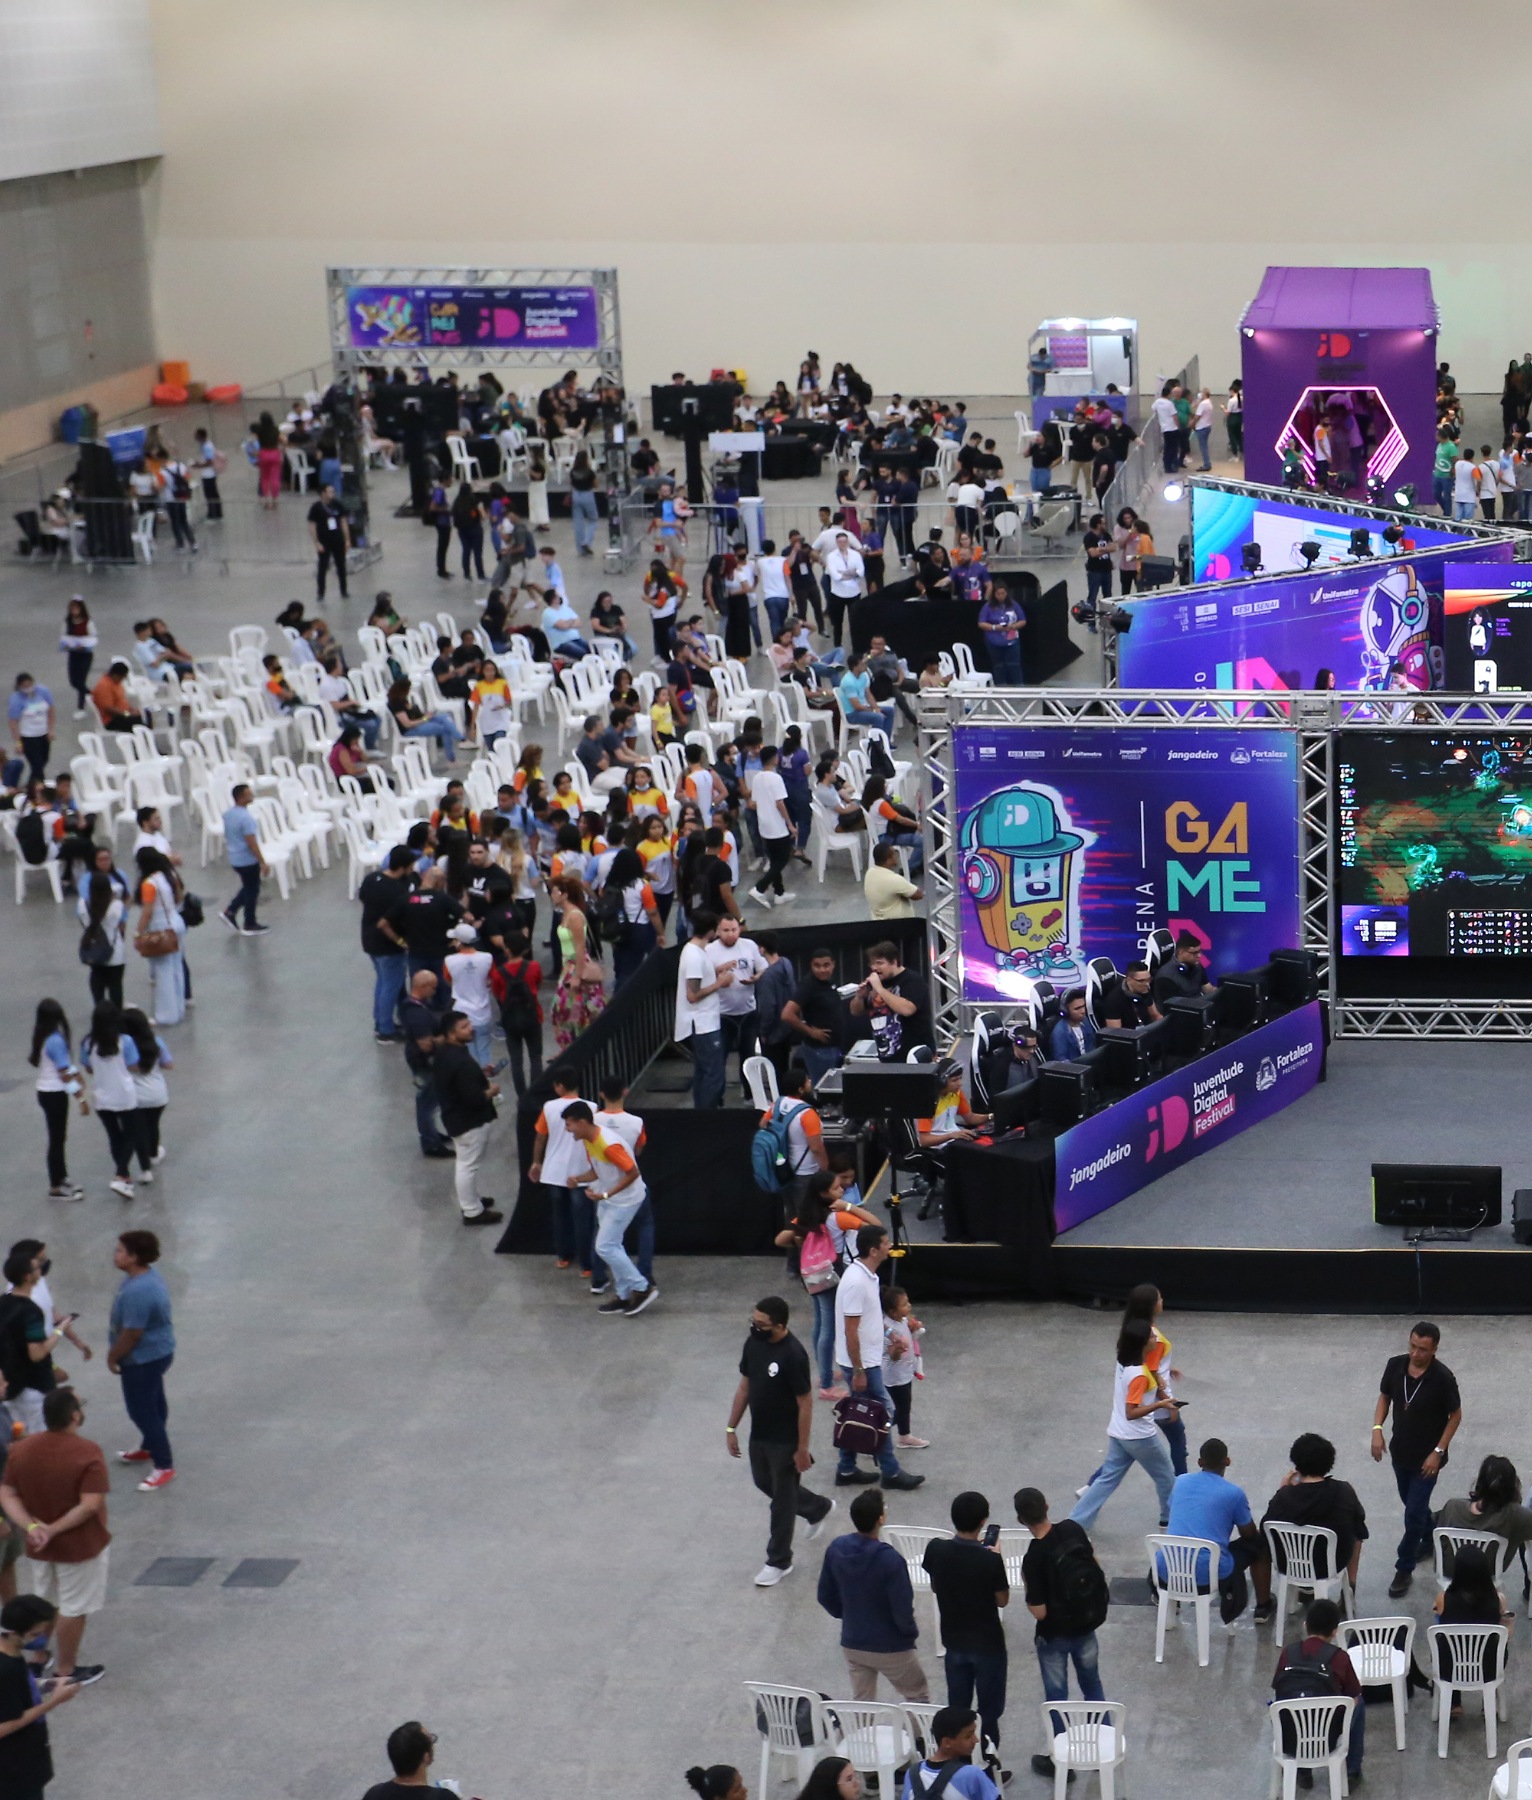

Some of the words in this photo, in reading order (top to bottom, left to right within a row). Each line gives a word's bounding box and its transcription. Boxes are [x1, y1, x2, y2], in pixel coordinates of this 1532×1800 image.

[1168, 750, 1218, 761] jangadeiro
[1251, 750, 1287, 758] Fortaleza
[1276, 1042, 1313, 1069] Fortaleza
[1193, 1061, 1244, 1098] Juventude
[1194, 1084, 1228, 1115] Digital
[1195, 1098, 1234, 1135] Festival
[1069, 1143, 1132, 1191] jangadeiro
